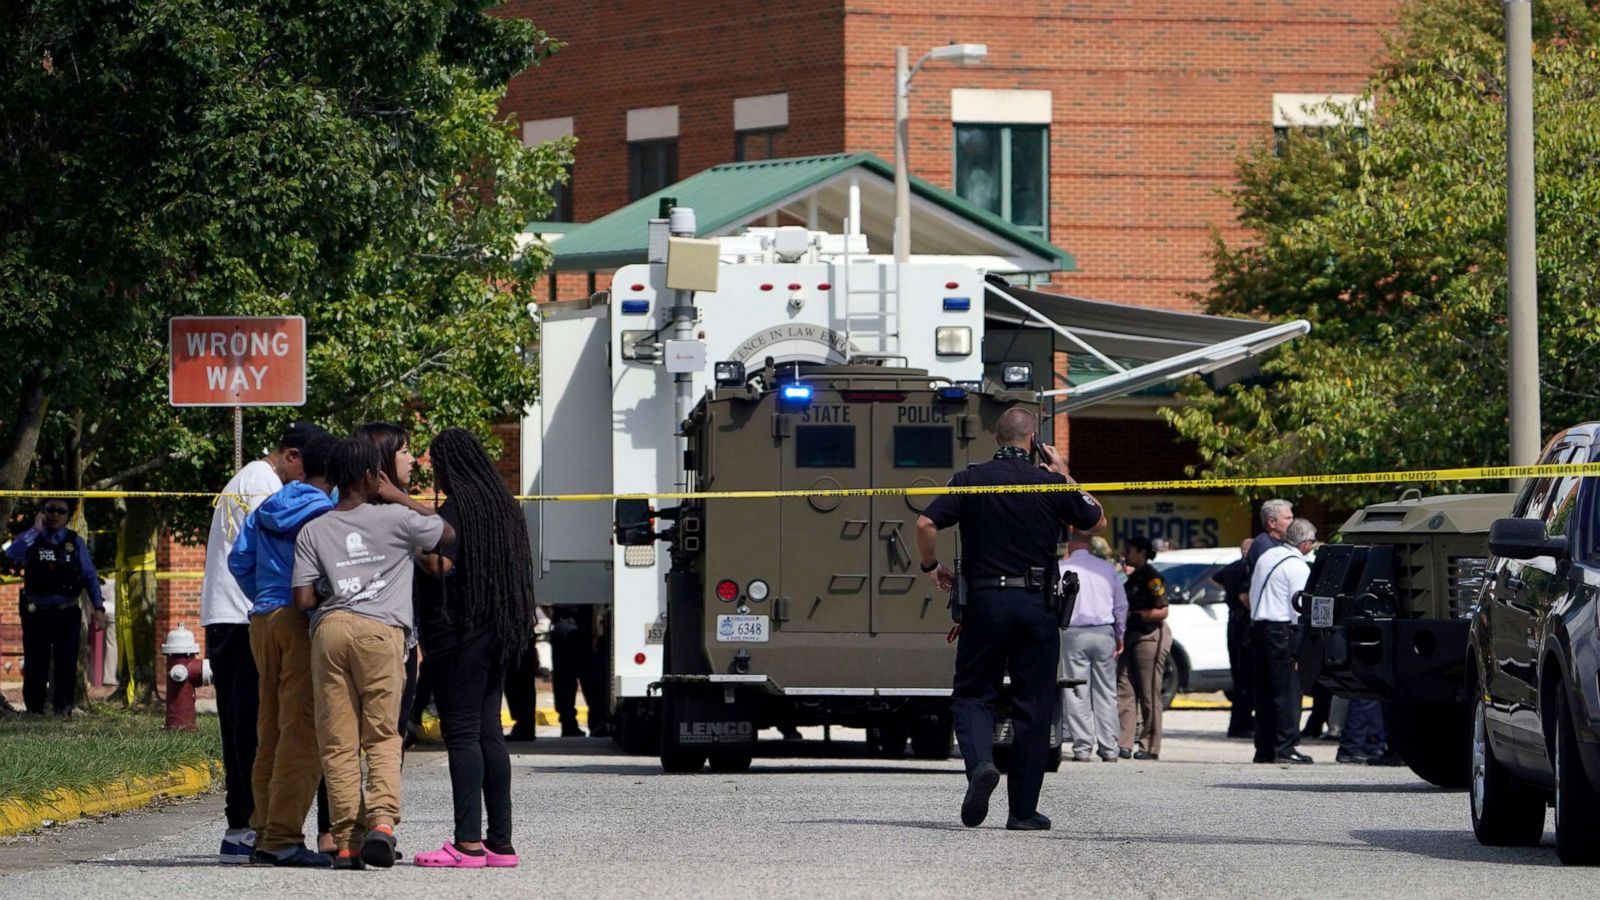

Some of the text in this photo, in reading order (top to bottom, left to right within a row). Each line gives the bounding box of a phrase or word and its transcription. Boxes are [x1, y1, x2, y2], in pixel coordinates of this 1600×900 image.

[770, 329, 783, 340] IN
[788, 327, 815, 337] LAW
[186, 332, 289, 357] WRONG
[206, 366, 268, 390] WAY
[802, 405, 950, 423] STATE POLICE
[1112, 517, 1219, 548] HEROES
[738, 622, 762, 635] 6348
[680, 721, 752, 736] LENCO
